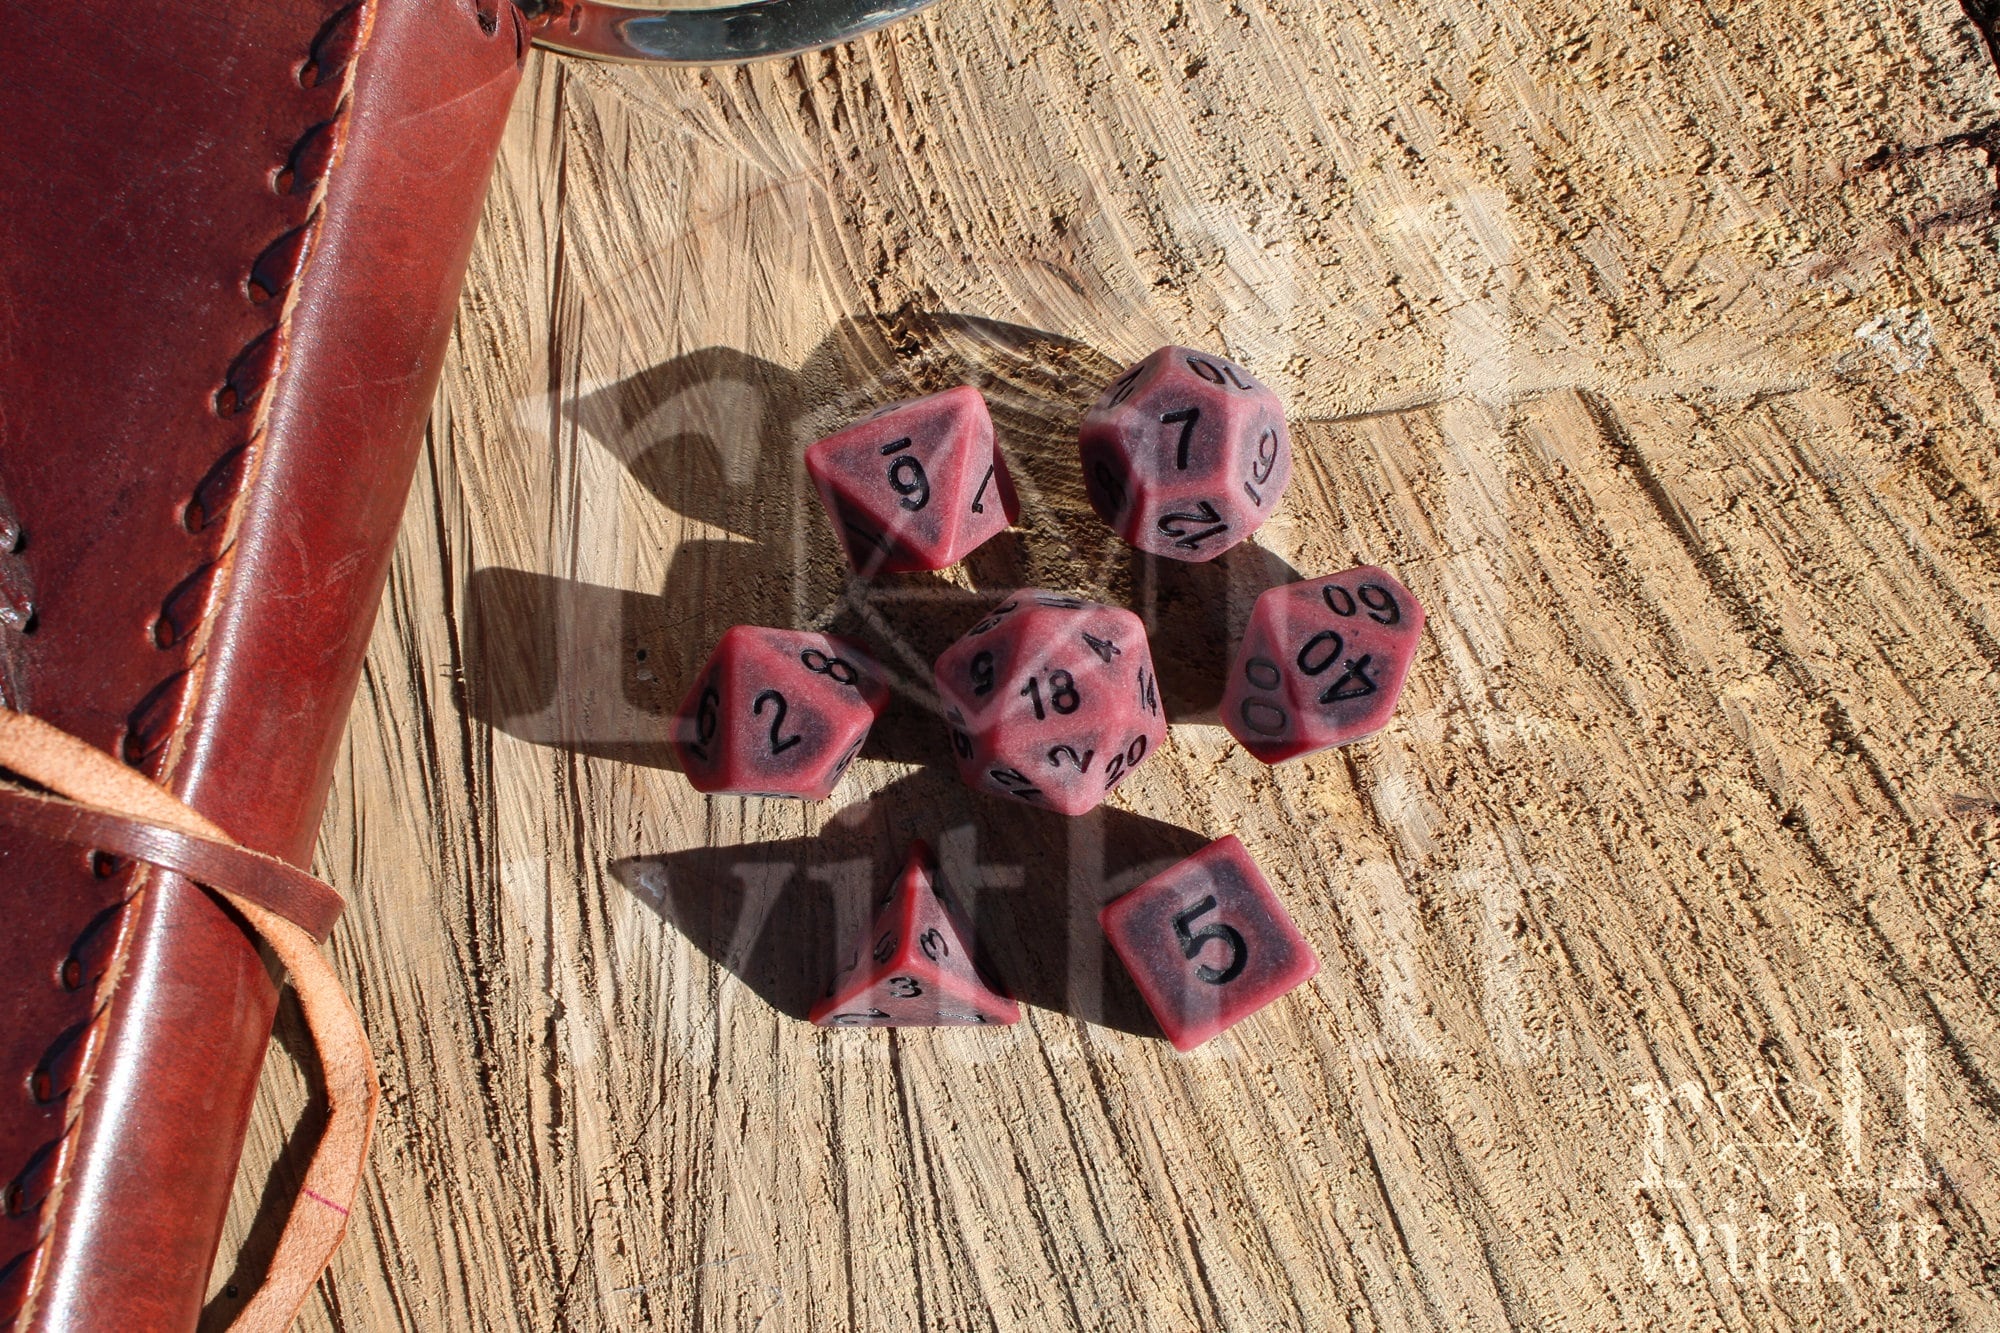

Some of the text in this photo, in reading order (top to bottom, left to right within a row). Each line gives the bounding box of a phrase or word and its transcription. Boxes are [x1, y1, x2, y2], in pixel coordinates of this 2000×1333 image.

[1159, 407, 1201, 471] 7
[1156, 500, 1229, 551] 12
[800, 648, 859, 686] 8
[1081, 632, 1122, 664] 4
[1020, 669, 1081, 721] 18
[752, 689, 802, 756] 2
[1048, 744, 1095, 774] 2
[1104, 734, 1148, 791] 20
[919, 928, 949, 962] 3
[1170, 894, 1248, 986] 5
[889, 976, 923, 999] 3
